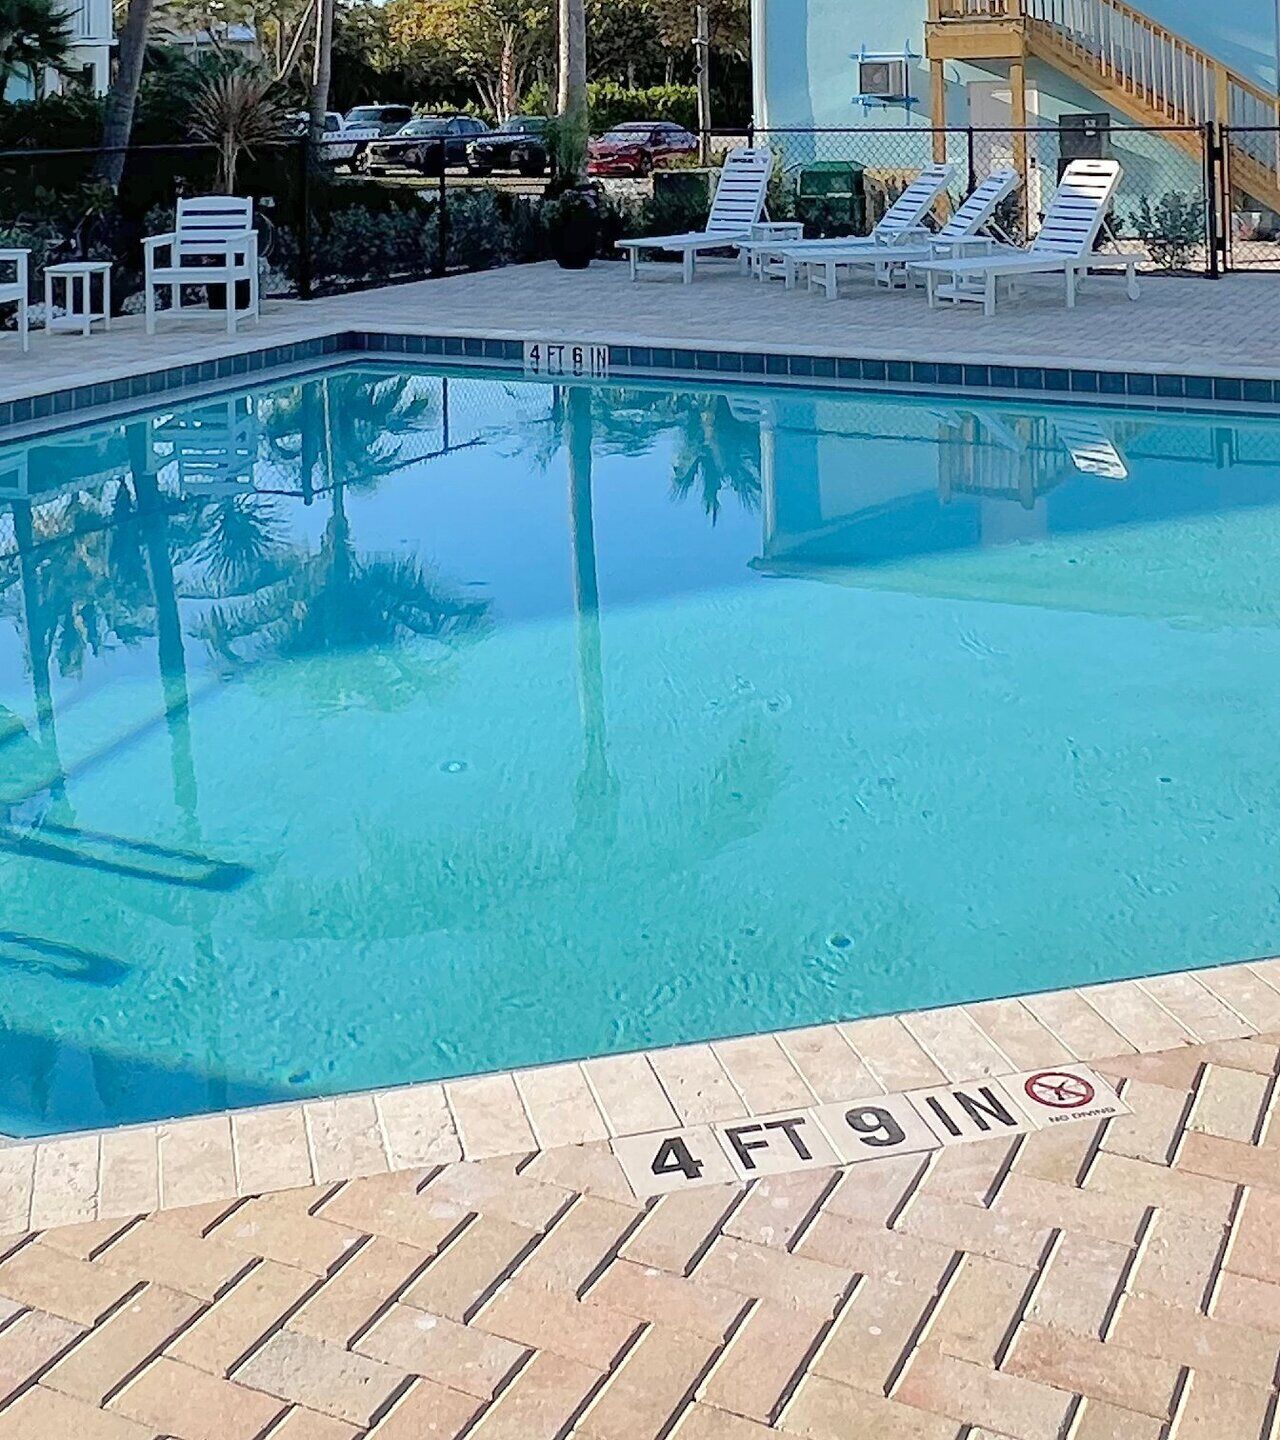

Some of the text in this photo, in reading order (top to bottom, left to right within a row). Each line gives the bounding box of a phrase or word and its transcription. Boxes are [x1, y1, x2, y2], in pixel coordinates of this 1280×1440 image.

[529, 344, 606, 366] 4 FT 6 IN
[1048, 1106, 1116, 1123] NO DIVING
[650, 1086, 1018, 1179] 4 FT 9 IN
